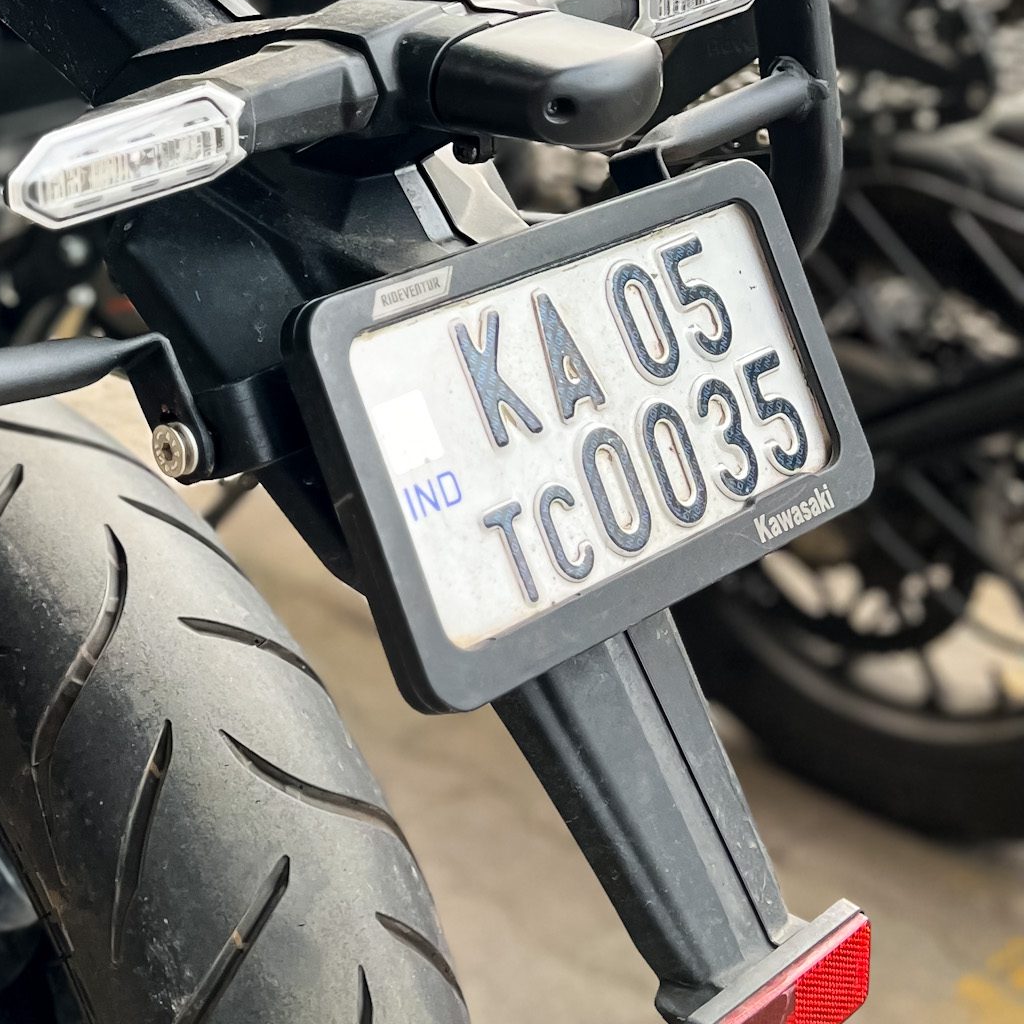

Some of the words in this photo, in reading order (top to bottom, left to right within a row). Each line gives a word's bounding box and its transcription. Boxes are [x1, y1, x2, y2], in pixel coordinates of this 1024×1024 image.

[380, 277, 441, 307] RIDEVENTUR
[454, 292, 606, 448] KA
[611, 235, 733, 380] 05
[403, 470, 463, 522] IND
[753, 483, 835, 544] Kawasaki
